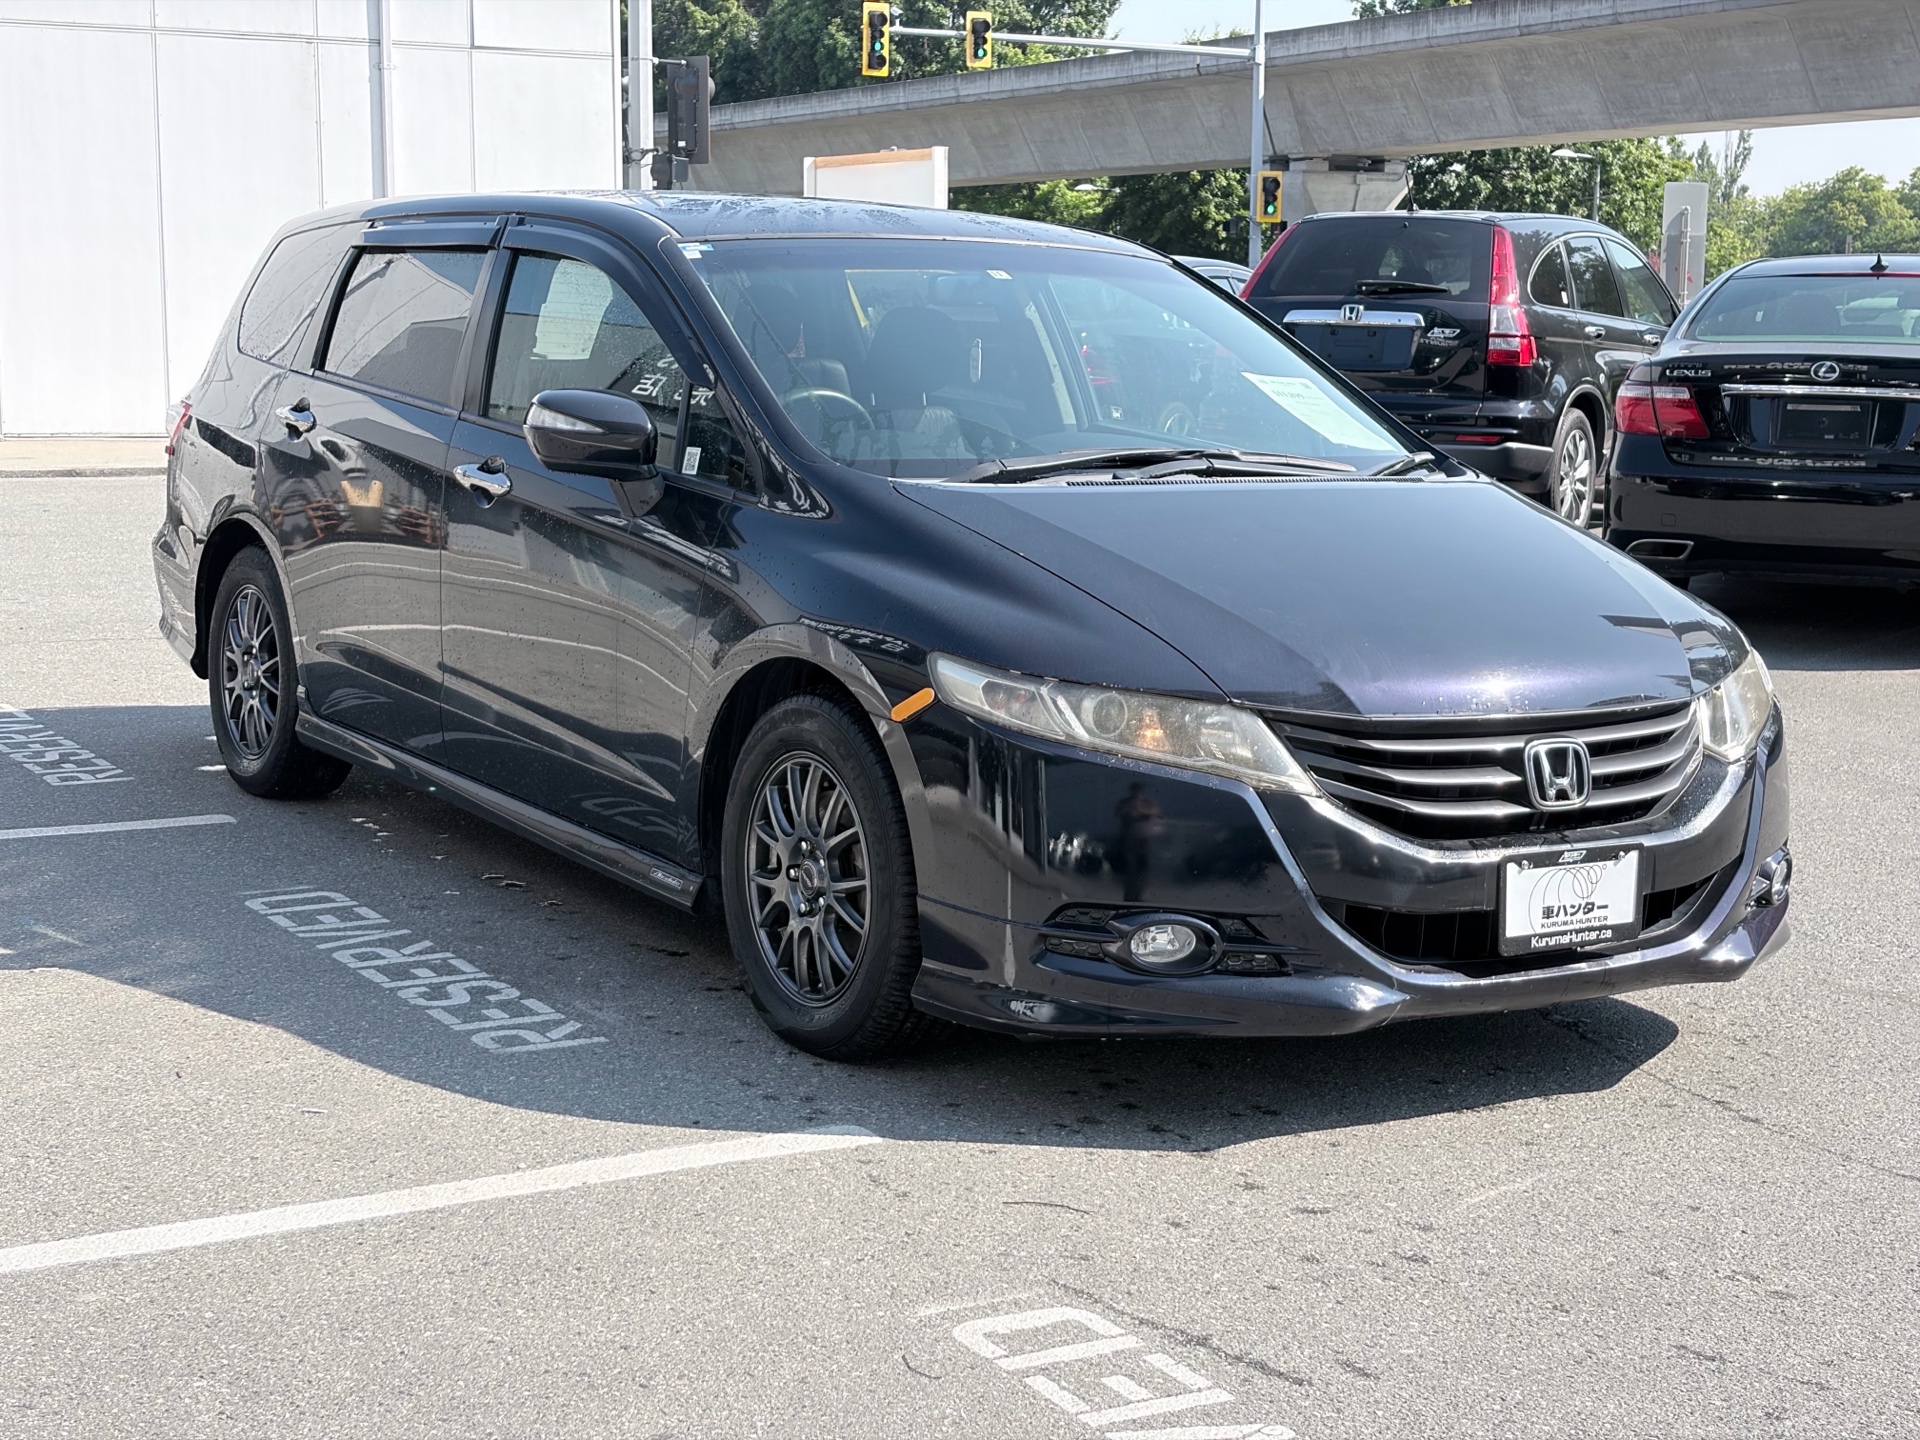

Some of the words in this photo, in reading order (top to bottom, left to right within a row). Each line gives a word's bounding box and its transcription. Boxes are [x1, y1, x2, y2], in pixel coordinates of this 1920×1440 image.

[1665, 368, 1712, 377] LEXUS
[1541, 901, 1609, 920] 車ハンター
[1540, 919, 1574, 929] KURUMA
[1575, 915, 1609, 925] HUNTER
[1531, 928, 1612, 948] KurumaHunter.ca
[244, 890, 610, 1054] RESERVED
